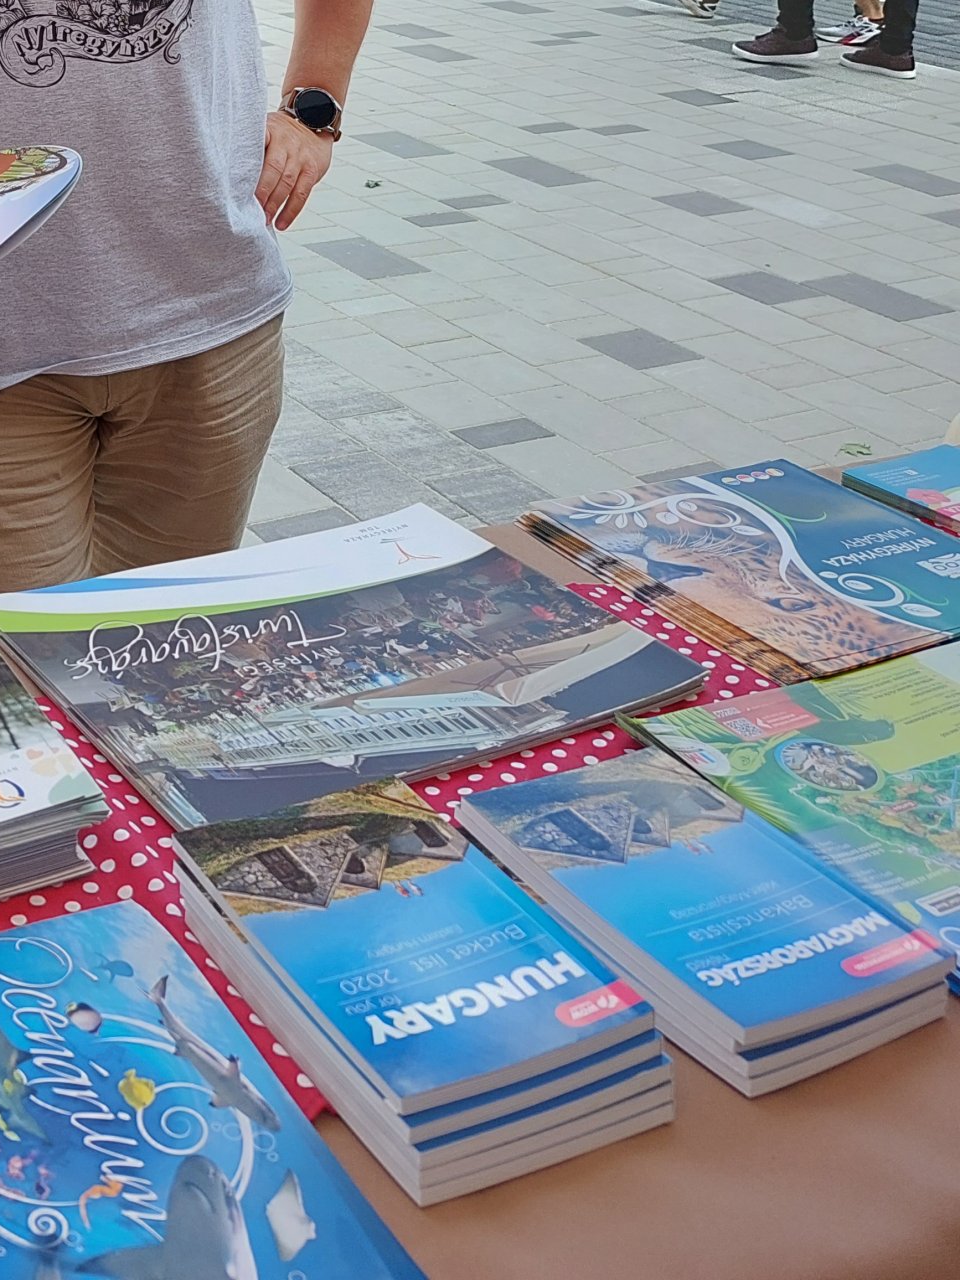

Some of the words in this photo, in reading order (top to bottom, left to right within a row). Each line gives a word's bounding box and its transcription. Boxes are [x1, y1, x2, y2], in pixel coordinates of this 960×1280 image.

[12, 19, 174, 57] Nyíregyháza
[822, 537, 936, 567] NYÍREGYHÁZA
[840, 527, 916, 549] HUNGARY
[63, 609, 347, 680] Turistavarázs
[233, 644, 341, 678] NYÍRSÉGI
[687, 894, 813, 943] Bakancslista
[449, 923, 526, 962] Bucket
[696, 911, 891, 986] MAGYARORSZÁG
[407, 951, 446, 975] list
[339, 968, 398, 994] 2020
[344, 1000, 373, 1017] you
[364, 952, 586, 1045] HUNGARY
[376, 992, 402, 1009] for
